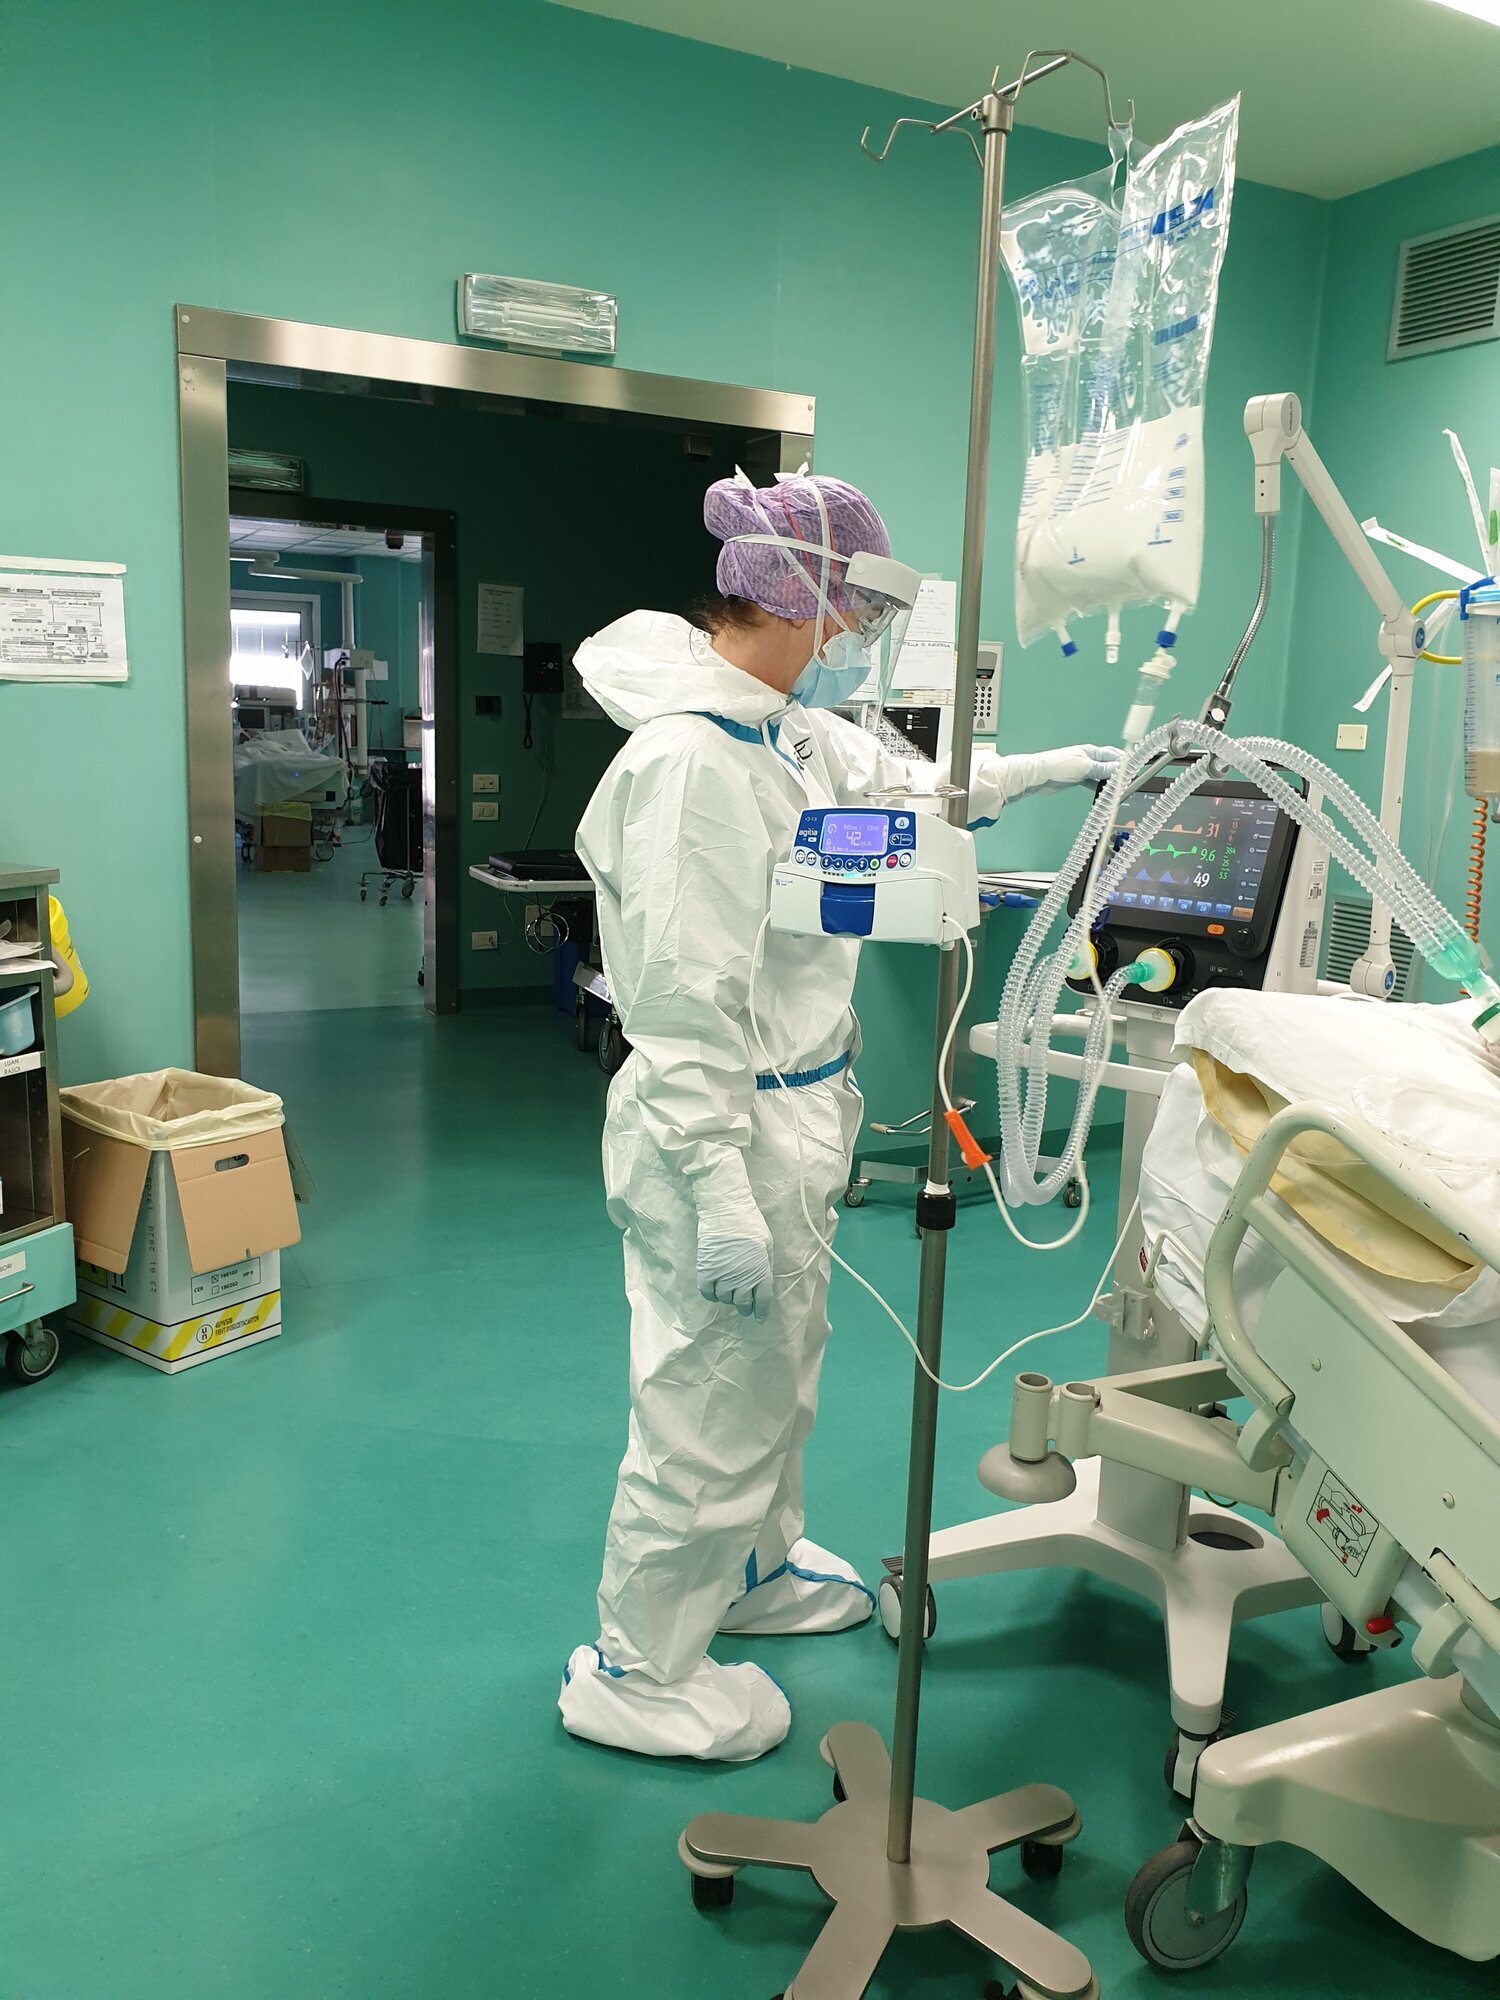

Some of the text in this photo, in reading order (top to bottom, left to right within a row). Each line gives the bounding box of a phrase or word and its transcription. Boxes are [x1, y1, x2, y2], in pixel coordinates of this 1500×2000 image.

[799, 828, 818, 837] agilia
[1206, 822, 1220, 838] 31
[846, 831, 861, 846] 42
[1228, 834, 1233, 842] 6
[1200, 848, 1216, 862] 9.6
[1193, 872, 1210, 888] 49
